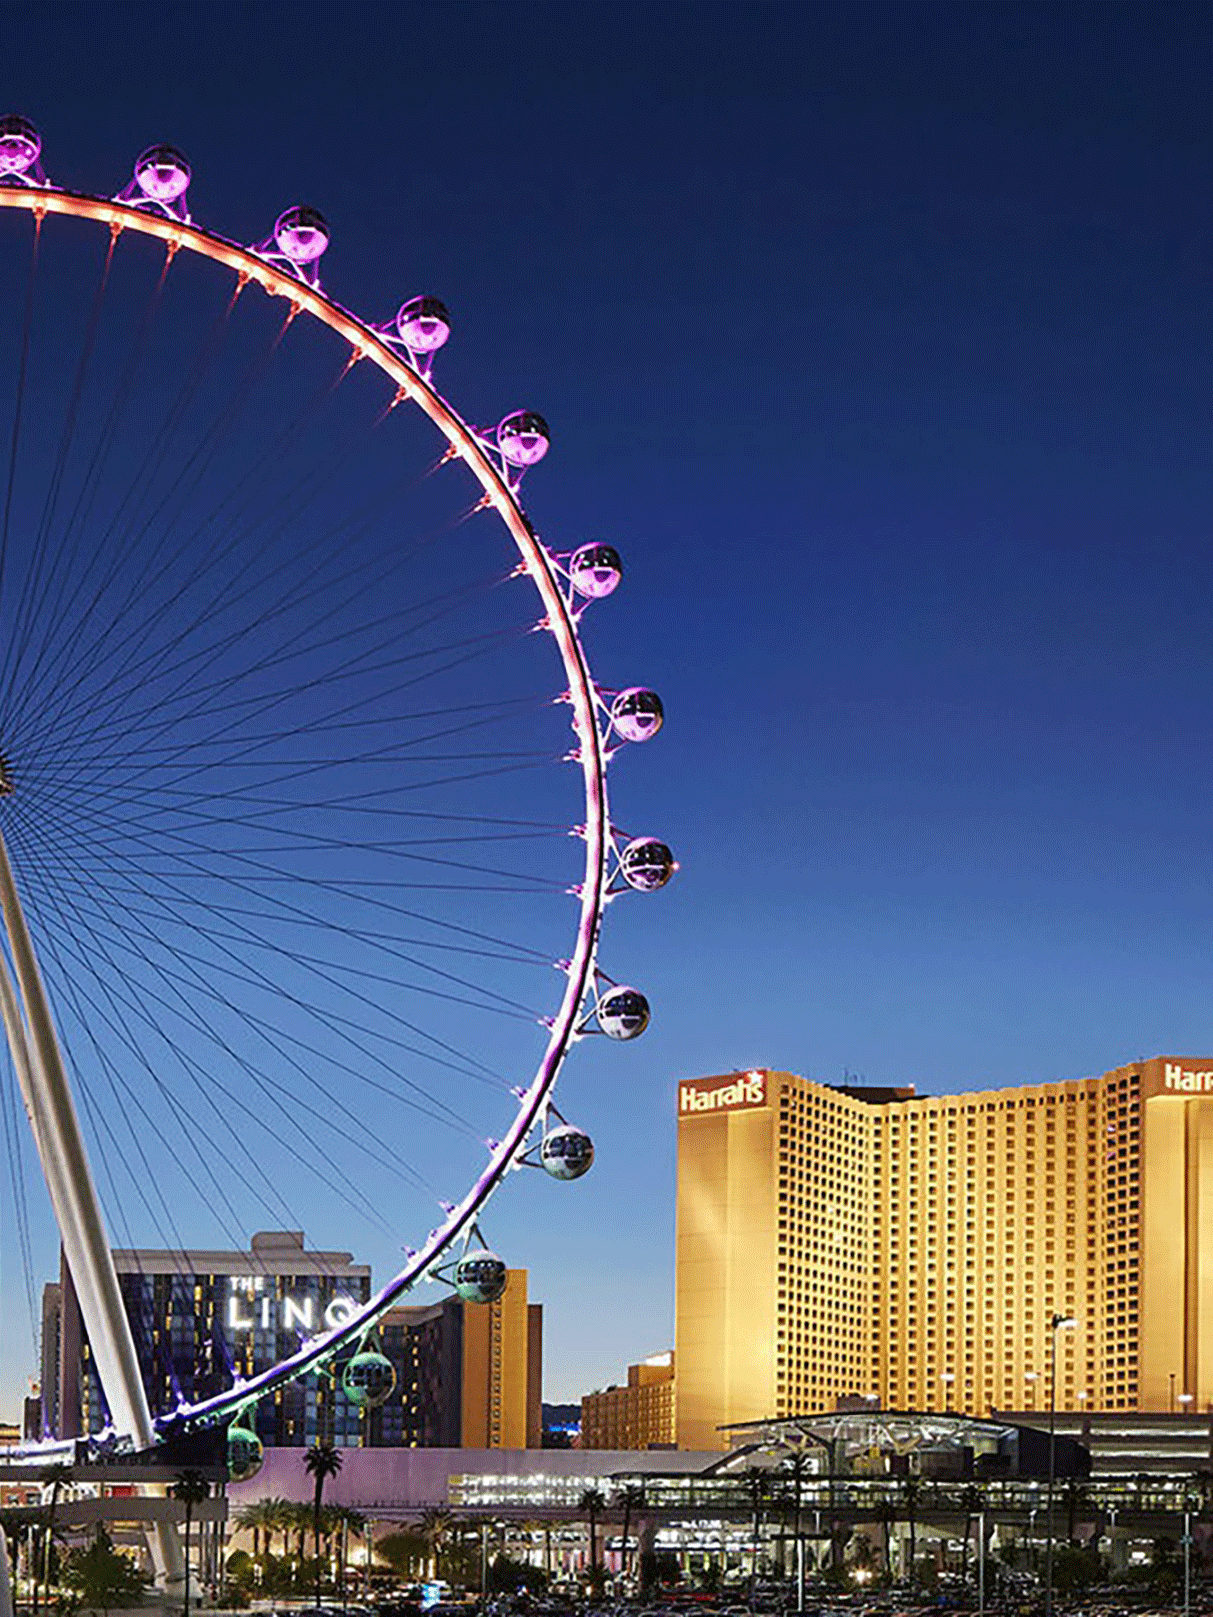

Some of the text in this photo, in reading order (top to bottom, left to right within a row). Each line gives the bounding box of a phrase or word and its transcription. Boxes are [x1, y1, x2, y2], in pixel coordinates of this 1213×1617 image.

[680, 1075, 764, 1111] Harrah's
[229, 1276, 264, 1290] THE
[229, 1297, 353, 1329] LINQ
